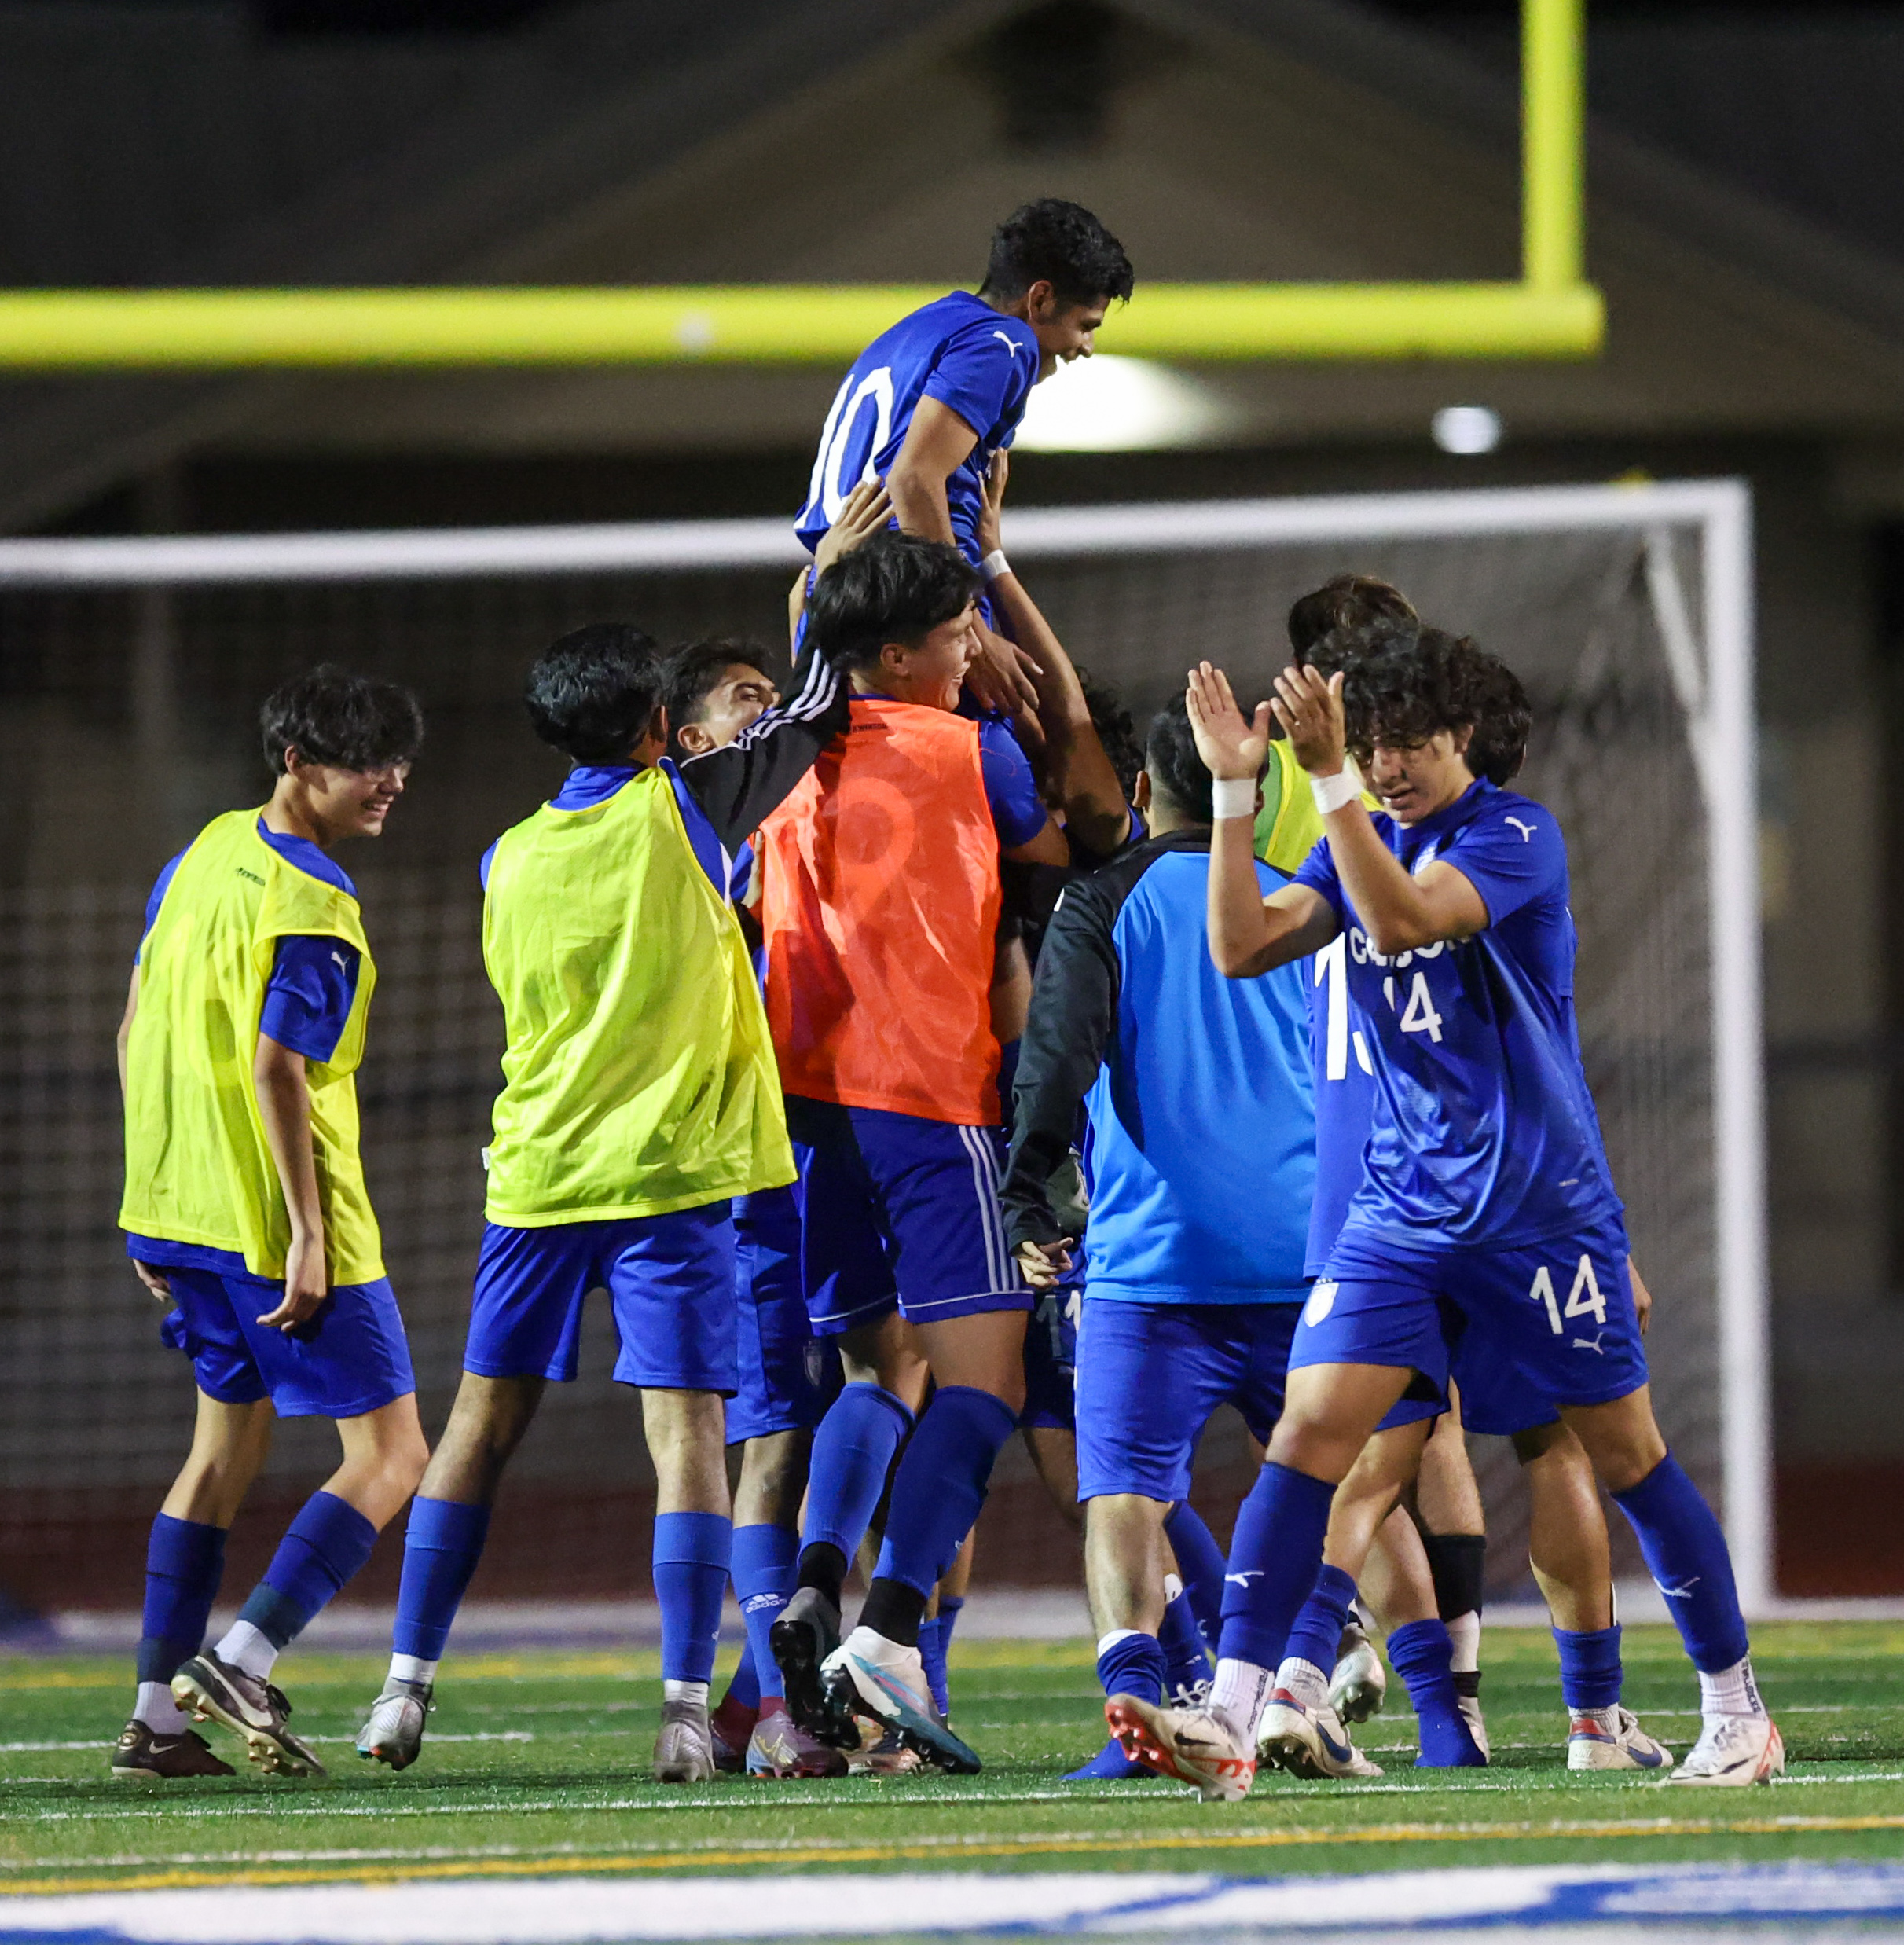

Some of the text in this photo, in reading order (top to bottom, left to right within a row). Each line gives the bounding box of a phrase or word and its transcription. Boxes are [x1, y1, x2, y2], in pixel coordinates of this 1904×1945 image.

[793, 365, 893, 530] 10
[1315, 932, 1374, 1081] 1
[1528, 1253, 1607, 1335] 14
[746, 1598, 787, 1613] adidas
